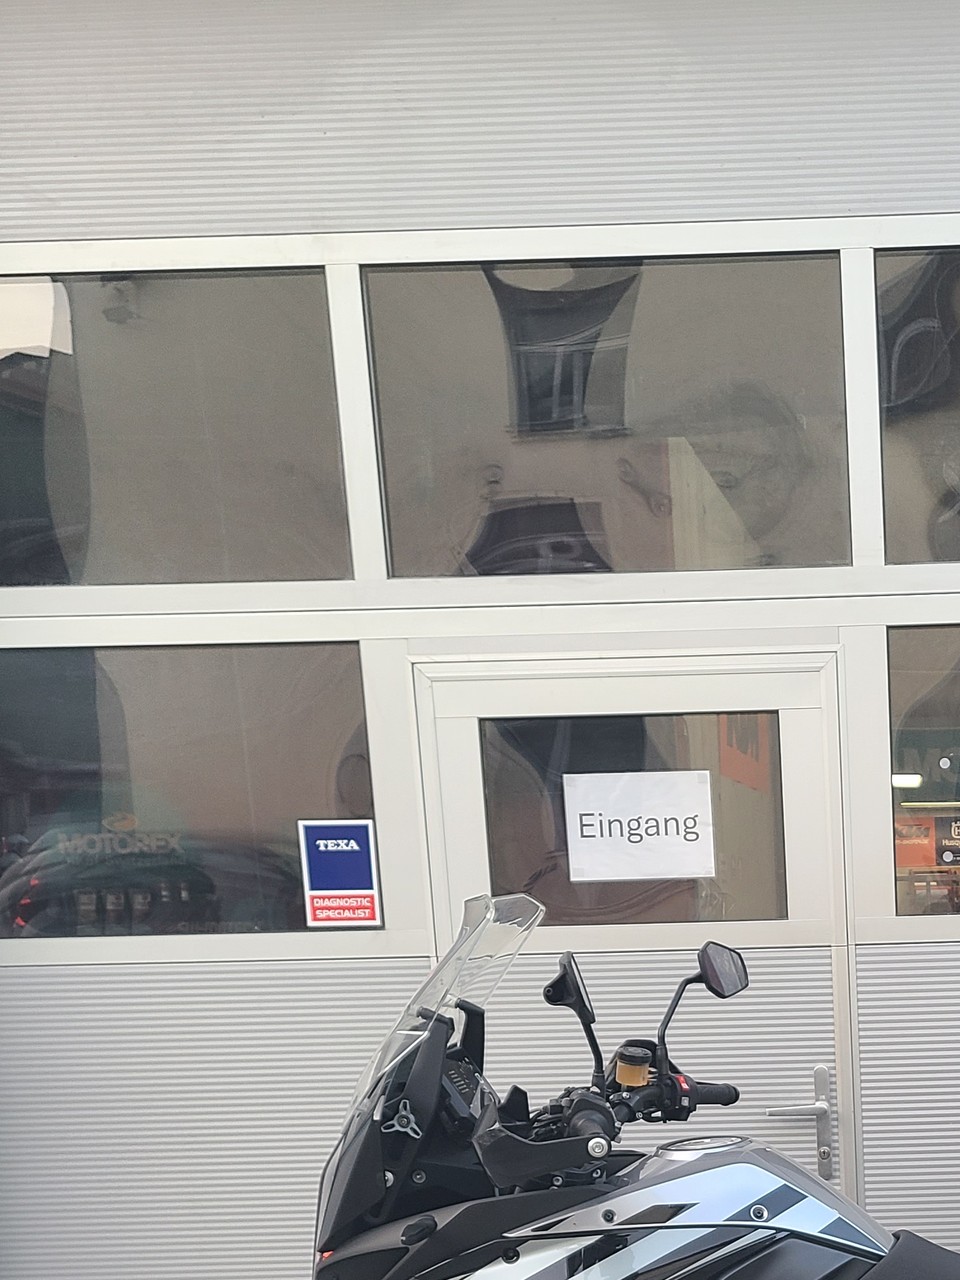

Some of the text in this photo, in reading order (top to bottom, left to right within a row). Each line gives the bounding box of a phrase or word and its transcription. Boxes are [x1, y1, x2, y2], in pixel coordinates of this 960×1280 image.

[578, 812, 700, 844] Eingang
[57, 832, 184, 854] MOTOREX
[315, 839, 361, 851] TEXA
[313, 897, 372, 907] DIAGNOSTIC
[316, 908, 371, 918] SPECIALIST
